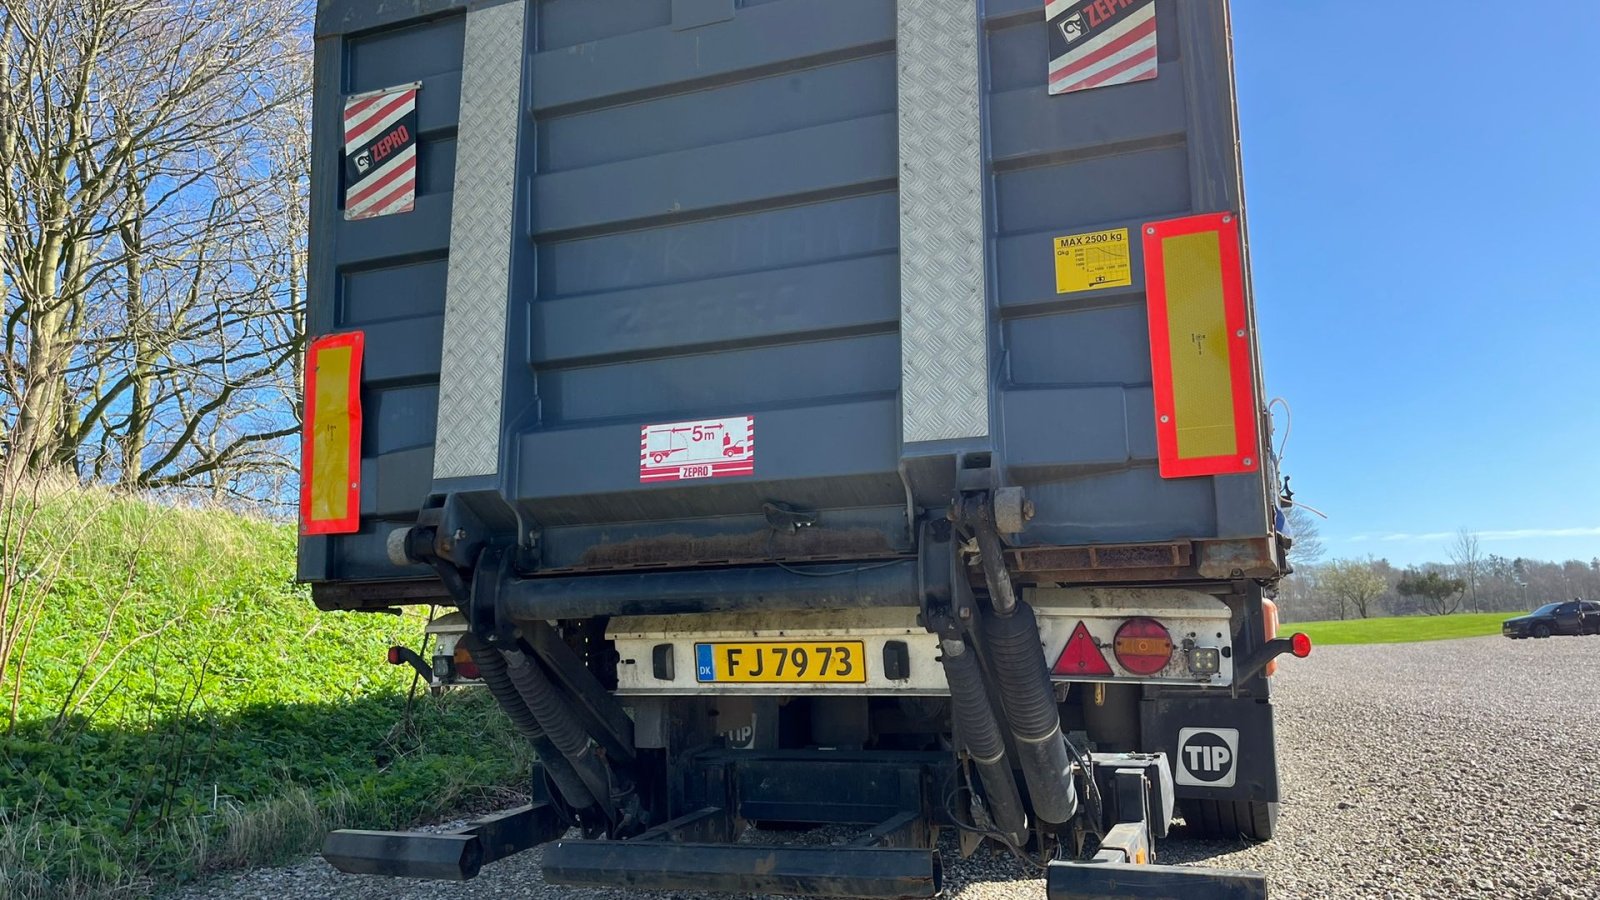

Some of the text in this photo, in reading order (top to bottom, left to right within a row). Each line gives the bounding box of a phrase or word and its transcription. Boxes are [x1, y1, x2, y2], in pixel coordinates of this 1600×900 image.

[370, 124, 410, 162] ZEPRO
[1060, 232, 1122, 247] MAX 2500 kg
[683, 466, 709, 478] ZEPRO
[699, 665, 711, 675] DK
[1185, 745, 1230, 771] TIP
